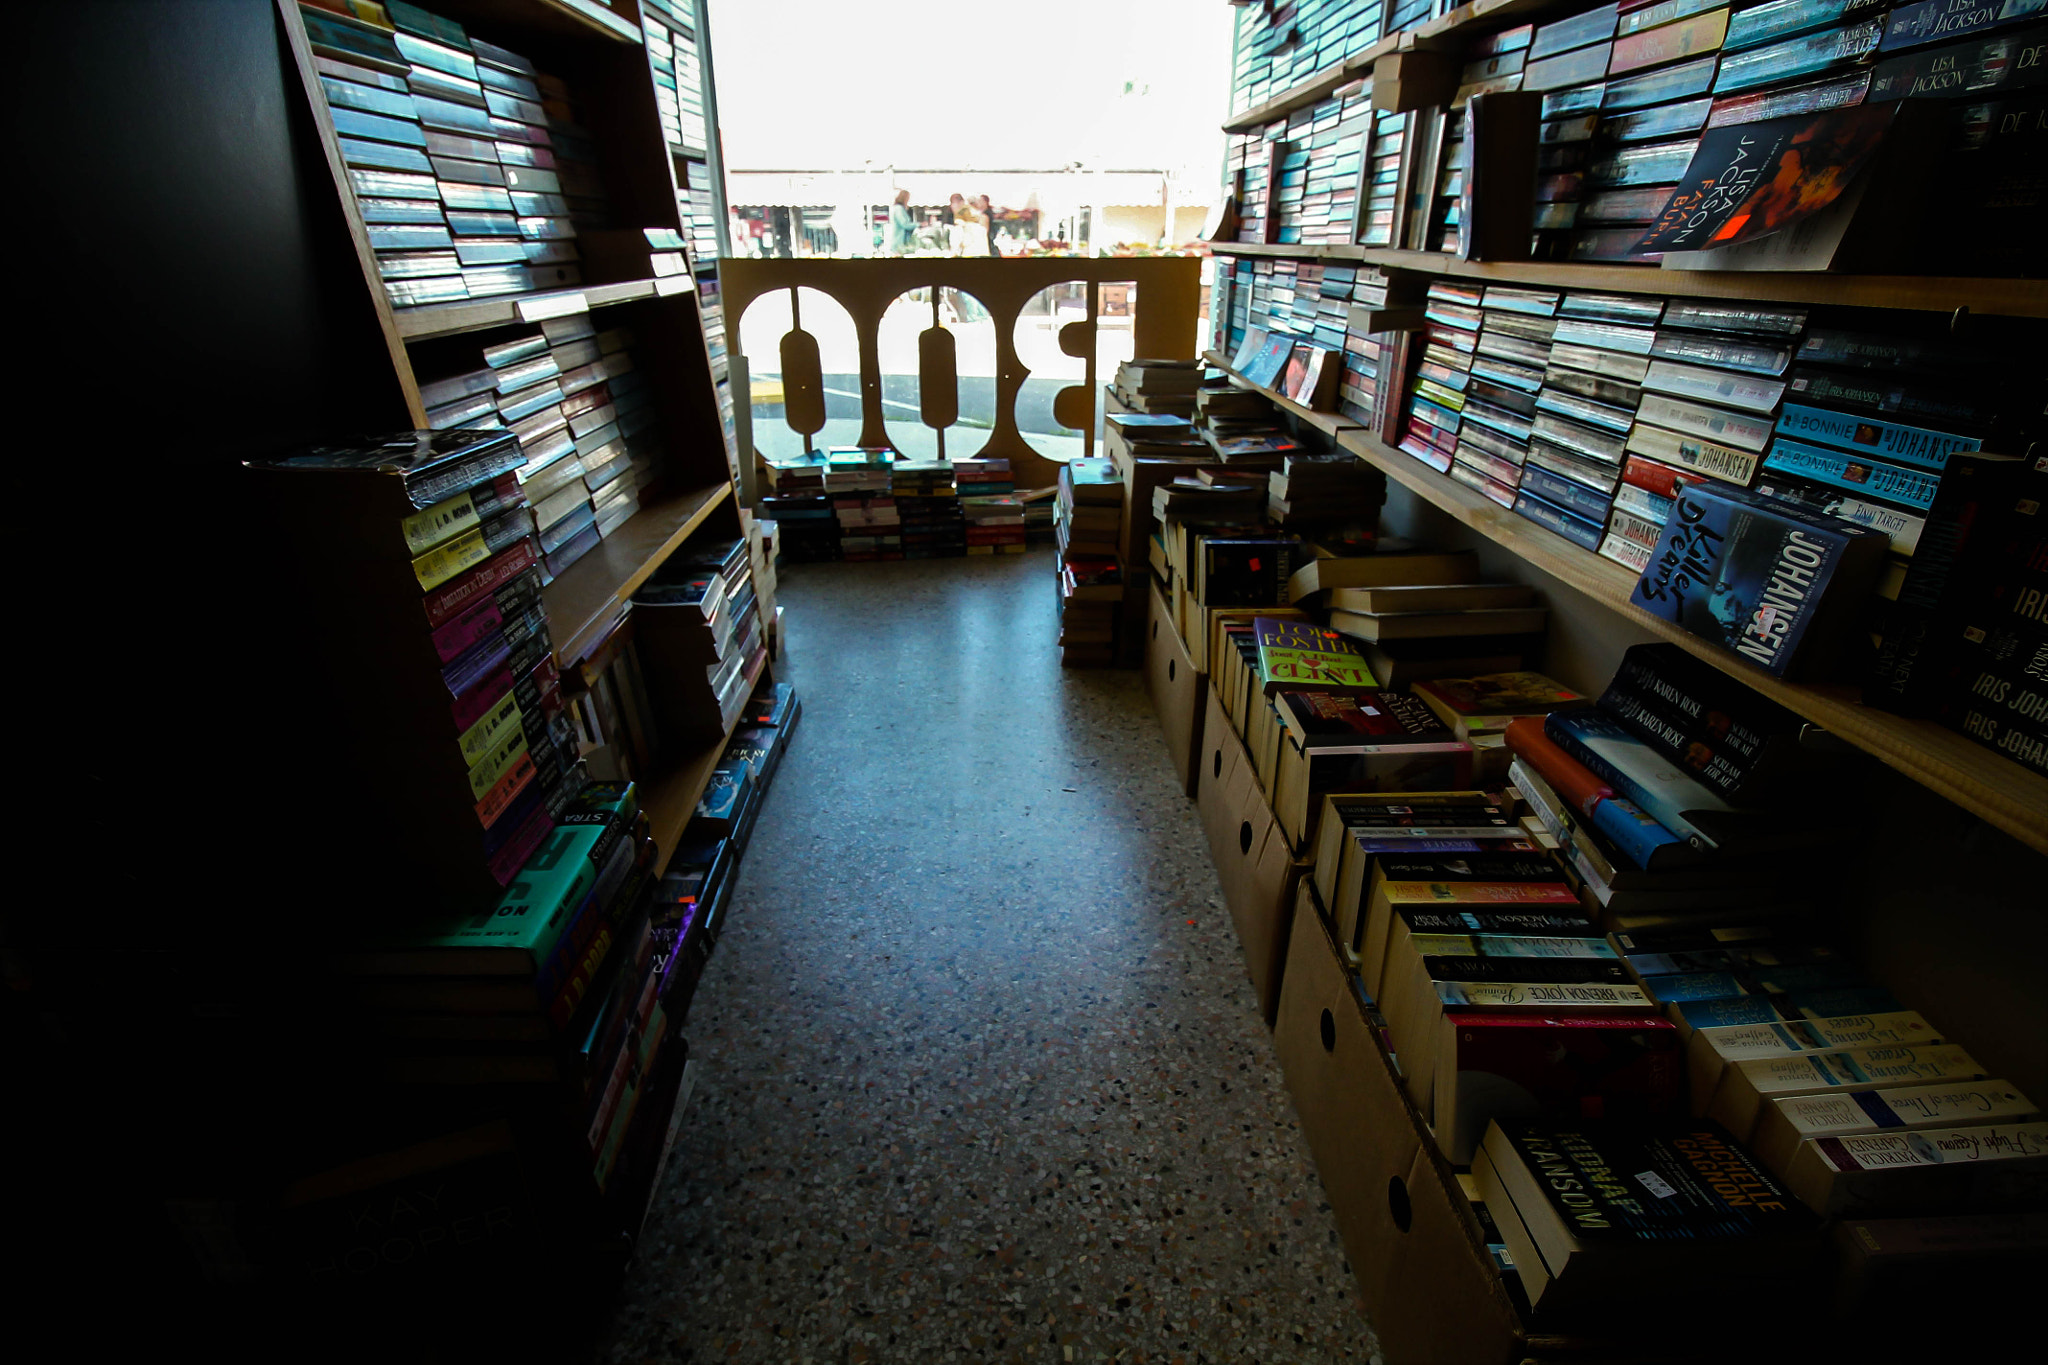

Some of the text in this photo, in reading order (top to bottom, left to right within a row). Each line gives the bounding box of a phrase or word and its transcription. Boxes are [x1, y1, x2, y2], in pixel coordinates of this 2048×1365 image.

[1947, 0, 1976, 14] LISA
[1932, 6, 2000, 35] JACKSON
[1835, 37, 1871, 58] DEAD
[1931, 55, 1956, 73] LISA
[1909, 70, 1967, 96] JACKSON
[1671, 134, 1756, 244] JACKSON
[1717, 167, 1758, 214] LISA
[1667, 179, 1713, 235] FATAL
[1642, 195, 1687, 245] BURN
[1843, 388, 1882, 402] JOHANSEN
[1799, 416, 1854, 439] BONNIE
[1698, 448, 1753, 481] JOHANSEN
[1790, 453, 1843, 476] BONNIE
[1853, 501, 1908, 533] FINAL TARGET
[1641, 496, 1707, 602] Dreams
[1670, 523, 1724, 623] Killer
[440, 584, 472, 610] IMITATION
[477, 568, 495, 588] DEATH
[1264, 633, 1360, 655] FOSTER
[1271, 663, 1367, 682] CLINT
[1653, 678, 1704, 719] KAREN ROSE
[1971, 671, 2011, 704] IRIS
[1635, 708, 1665, 735] KAREN
[1663, 726, 1687, 750] ROSE
[1730, 723, 1761, 747] SCREAM
[1963, 710, 1997, 741] IRIS
[1724, 735, 1754, 759] FOR ME
[1703, 765, 1733, 790] FOR ME
[1712, 754, 1742, 779] SCREAM
[564, 813, 604, 822] STRA
[1422, 839, 1473, 849] BAXTER
[1496, 915, 1549, 925] JACKSON
[1513, 937, 1583, 948] LONDON
[1528, 986, 1615, 1001] BRENDA JOYCE
[1825, 1025, 1878, 1047] Saving
[1827, 1016, 1875, 1033] Graces
[1867, 1046, 1916, 1064] Graces
[1770, 1061, 1812, 1075] Gaffney
[1777, 1071, 1819, 1082] Patricia
[1862, 1060, 1918, 1082] Saving
[1791, 1098, 1850, 1116] GAFFNEY
[1890, 1090, 1992, 1118] Circle of Three
[1804, 1111, 1859, 1129] PATRICIA
[1843, 1133, 1911, 1154] GAFFNEY
[1857, 1149, 1921, 1167] PATRICIA
[1522, 1137, 1612, 1229] RANSOM
[1552, 1131, 1647, 1216] KIDNAP
[1670, 1138, 1750, 1208] GAGNON
[1688, 1131, 1788, 1213] MICHELLE
[343, 1181, 449, 1233] KAY
[303, 1203, 514, 1286] HOOPER
